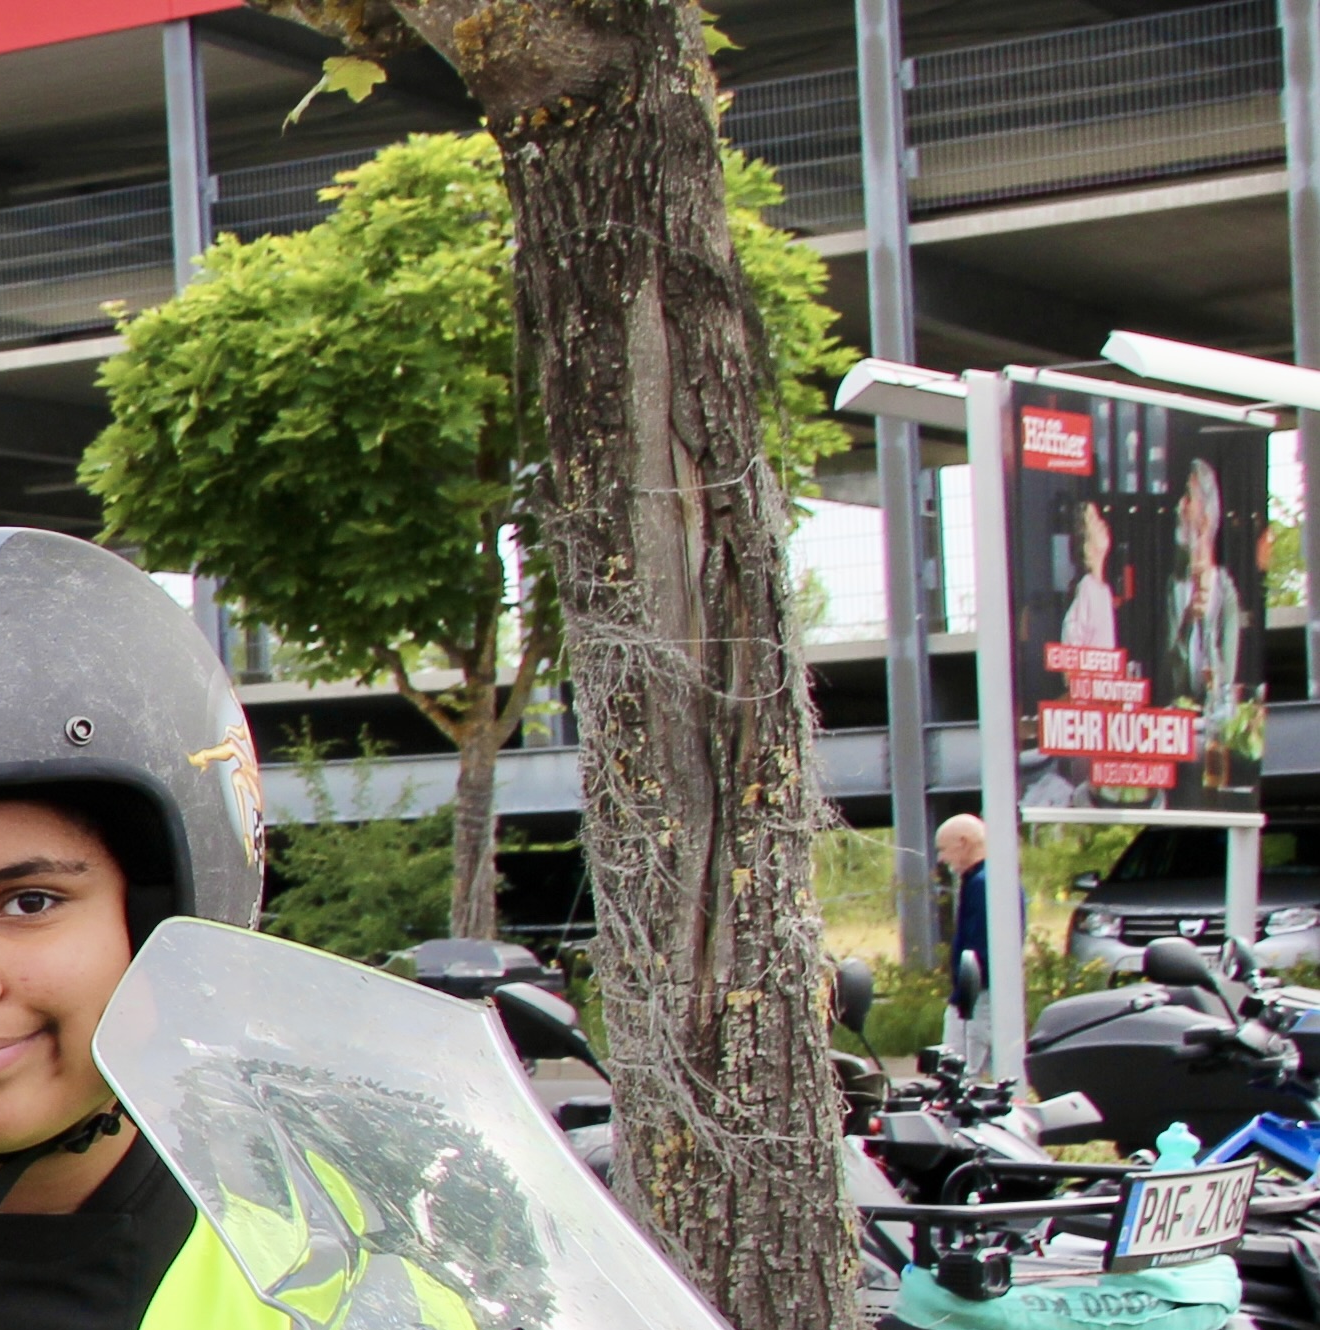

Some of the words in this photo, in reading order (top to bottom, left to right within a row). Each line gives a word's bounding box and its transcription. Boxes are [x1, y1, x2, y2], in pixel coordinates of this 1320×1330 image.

[1022, 414, 1087, 458] Höffner
[1042, 708, 1104, 751] MEHR
[1107, 702, 1190, 756] KÜCHEN
[1134, 1183, 1193, 1244] PAF
[1193, 1178, 1233, 1237] ZX
